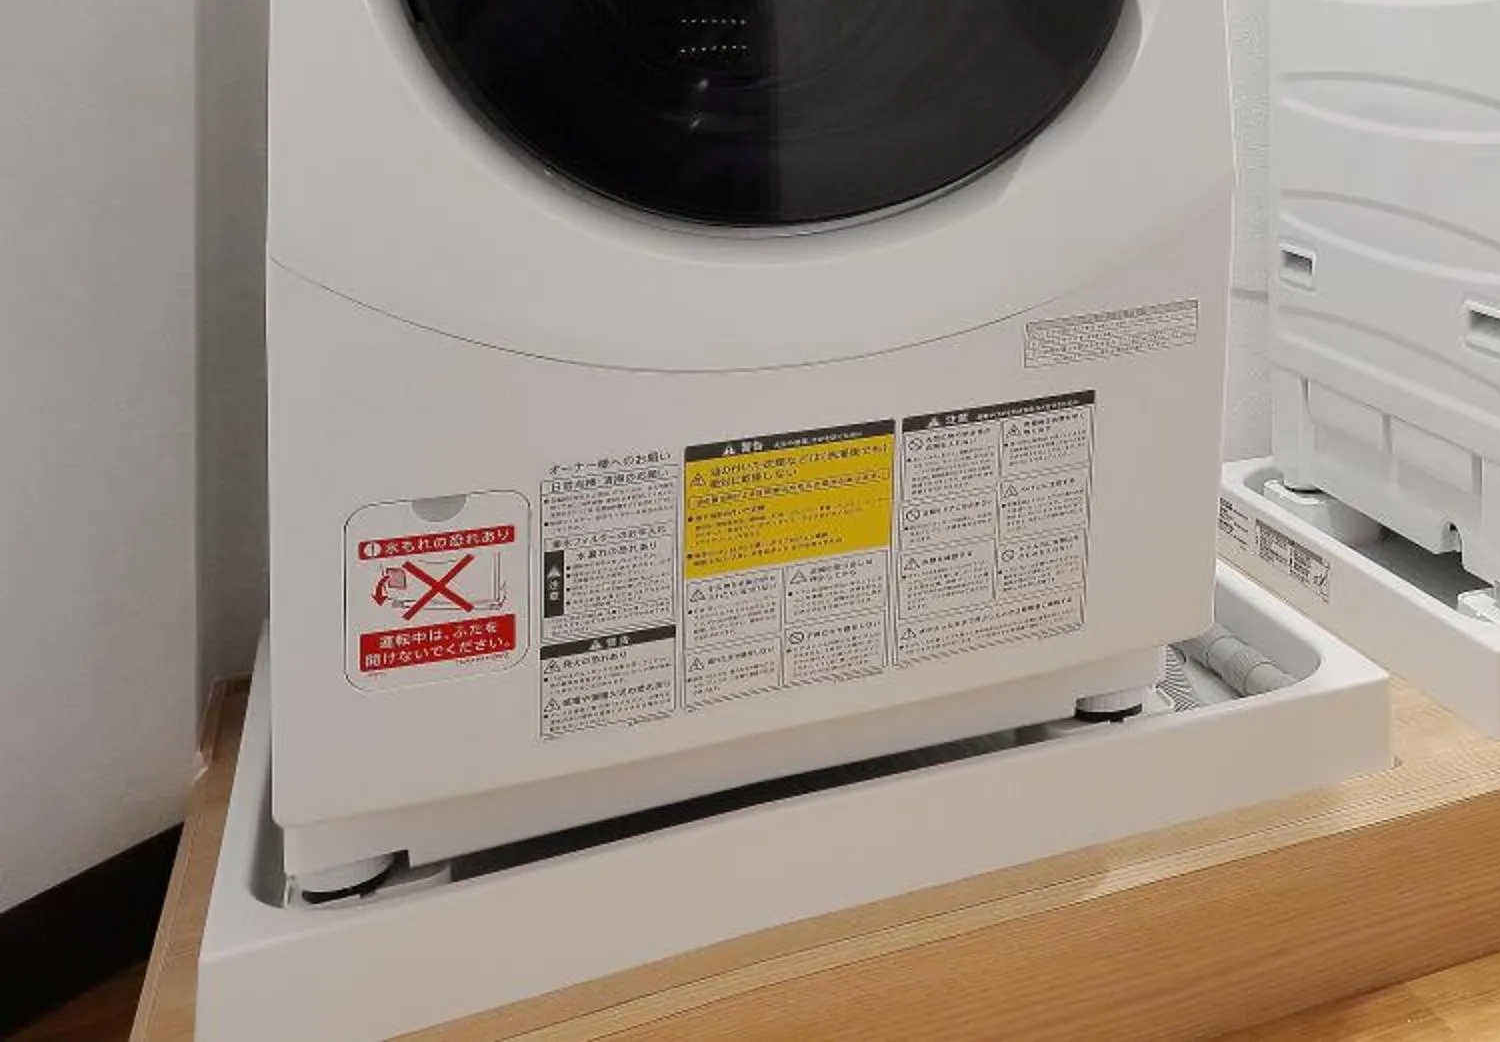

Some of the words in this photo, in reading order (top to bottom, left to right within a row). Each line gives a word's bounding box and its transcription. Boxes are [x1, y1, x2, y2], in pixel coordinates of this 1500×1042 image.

[385, 529, 510, 555] 水もれの恐れあり
[379, 621, 498, 649] 運転中は、ふたを
[365, 639, 511, 667] 開けないでください。
